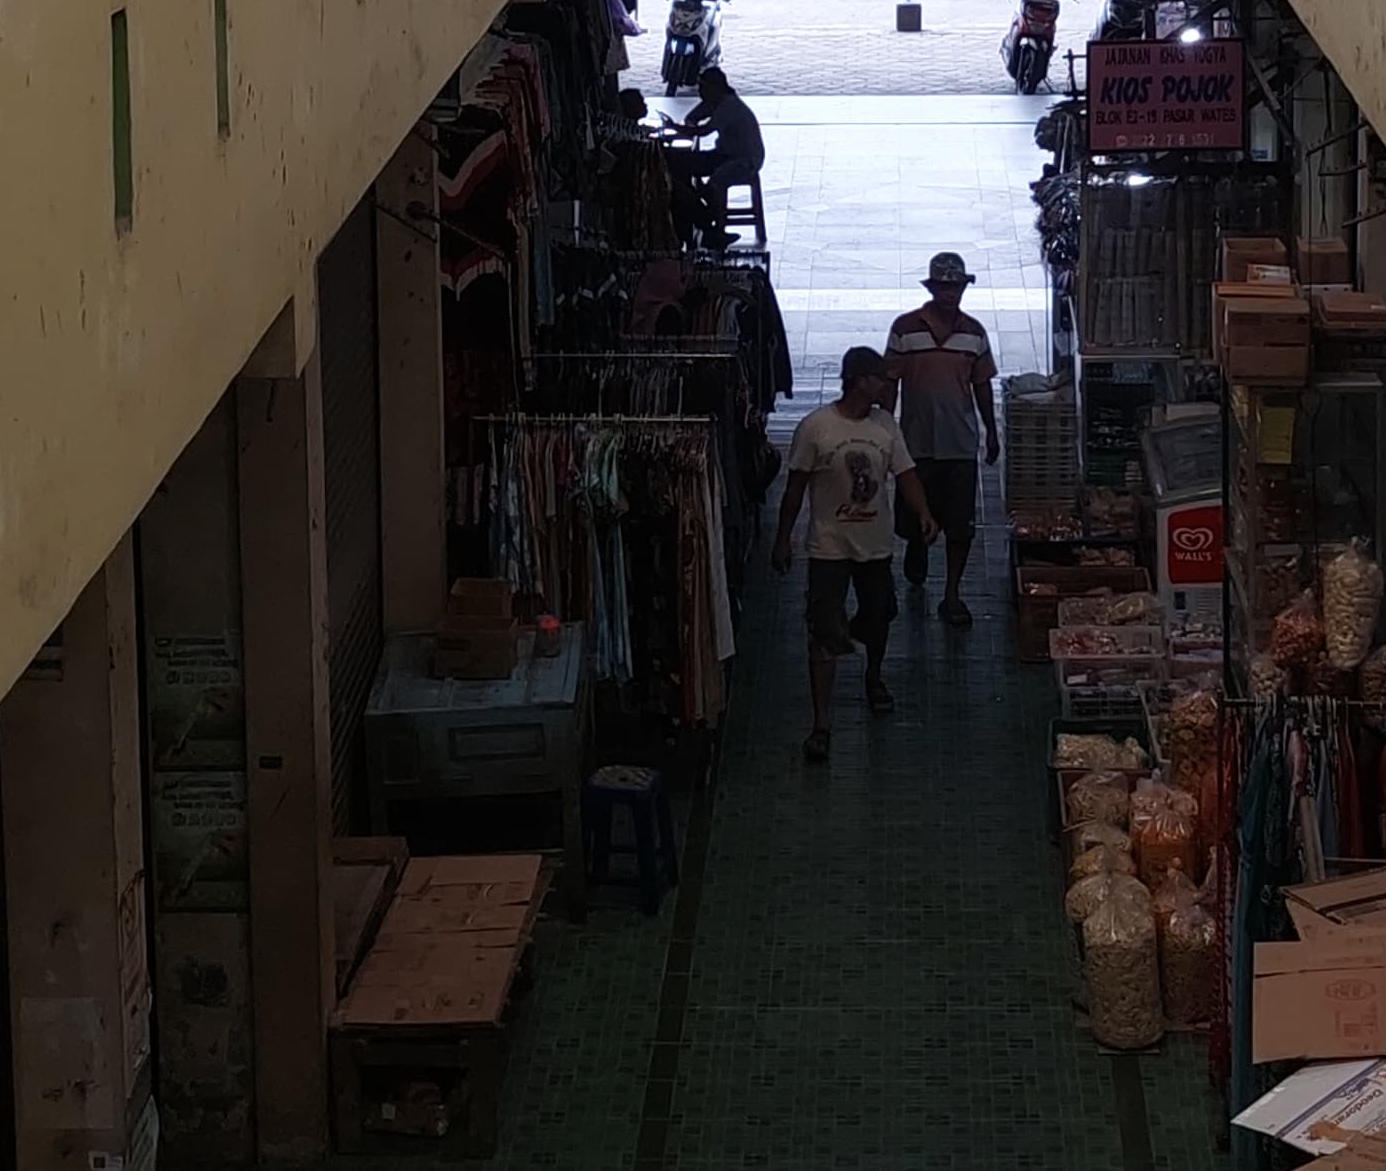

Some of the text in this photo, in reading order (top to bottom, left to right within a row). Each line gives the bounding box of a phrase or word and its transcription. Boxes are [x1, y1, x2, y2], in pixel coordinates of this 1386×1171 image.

[1104, 47, 1152, 67] JAJANAN
[1160, 47, 1186, 63] KHAS
[1100, 75, 1235, 105] KIOS POJOK
[1095, 109, 1122, 125] BLOK
[1163, 108, 1196, 123] PASAR
[1201, 108, 1236, 123] WATES
[1173, 550, 1213, 563] WALL'S
